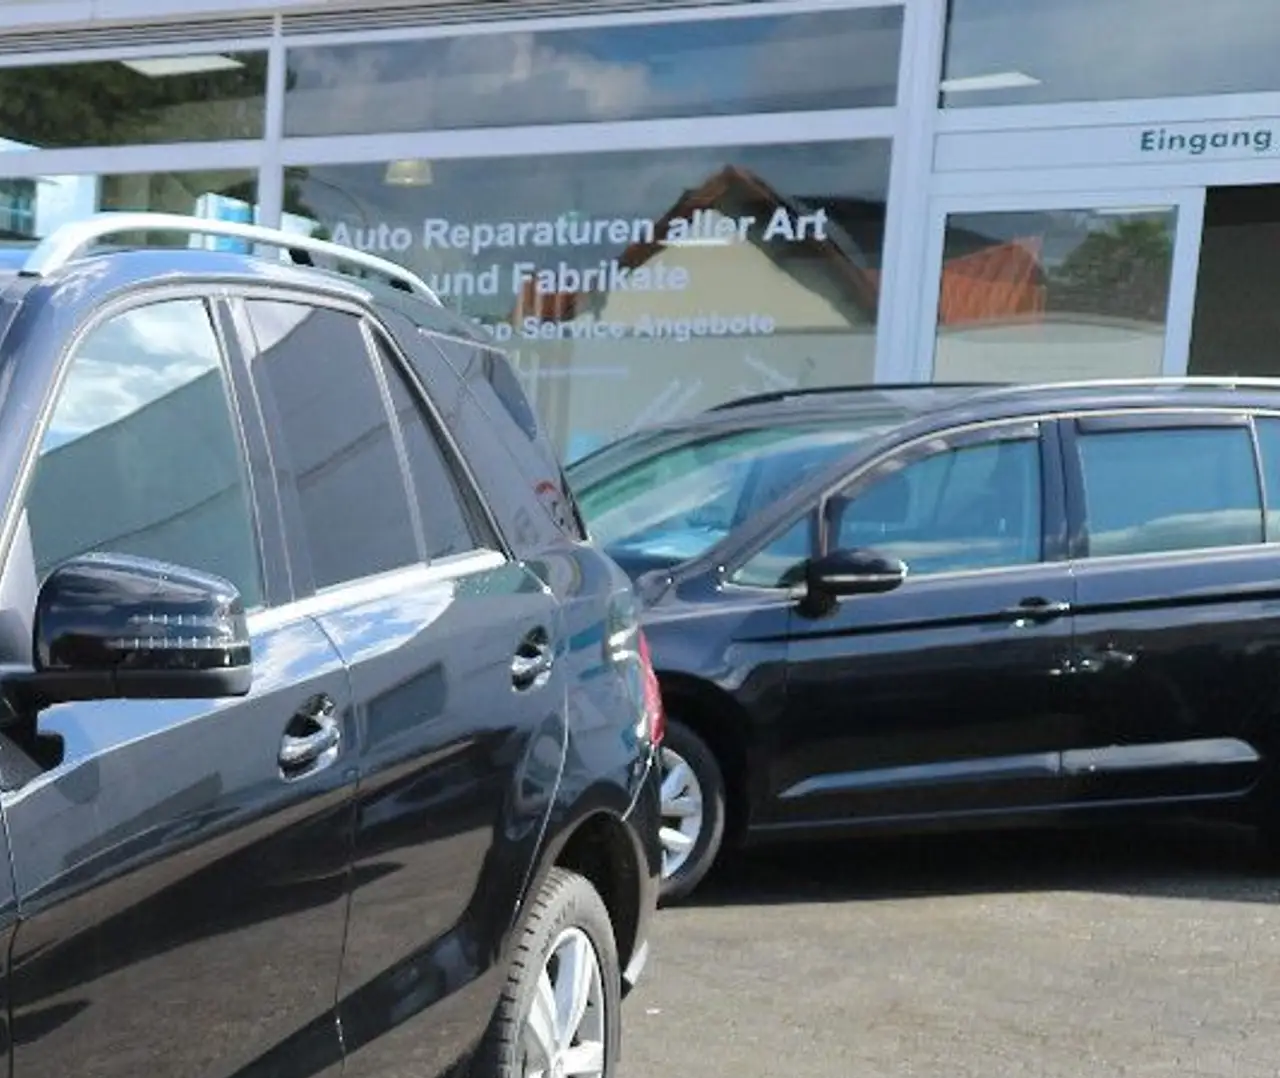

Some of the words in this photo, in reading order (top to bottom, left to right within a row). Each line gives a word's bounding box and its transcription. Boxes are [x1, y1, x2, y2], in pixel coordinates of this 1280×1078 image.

[1140, 129, 1272, 155] Eingang
[332, 221, 413, 250] Auto
[425, 215, 654, 253] Reparaturen
[666, 209, 756, 242] aller
[764, 207, 828, 242] Art
[434, 262, 500, 295] und
[513, 260, 689, 294] Fabrikate
[523, 314, 626, 340] Service
[635, 313, 776, 341] Angebote
